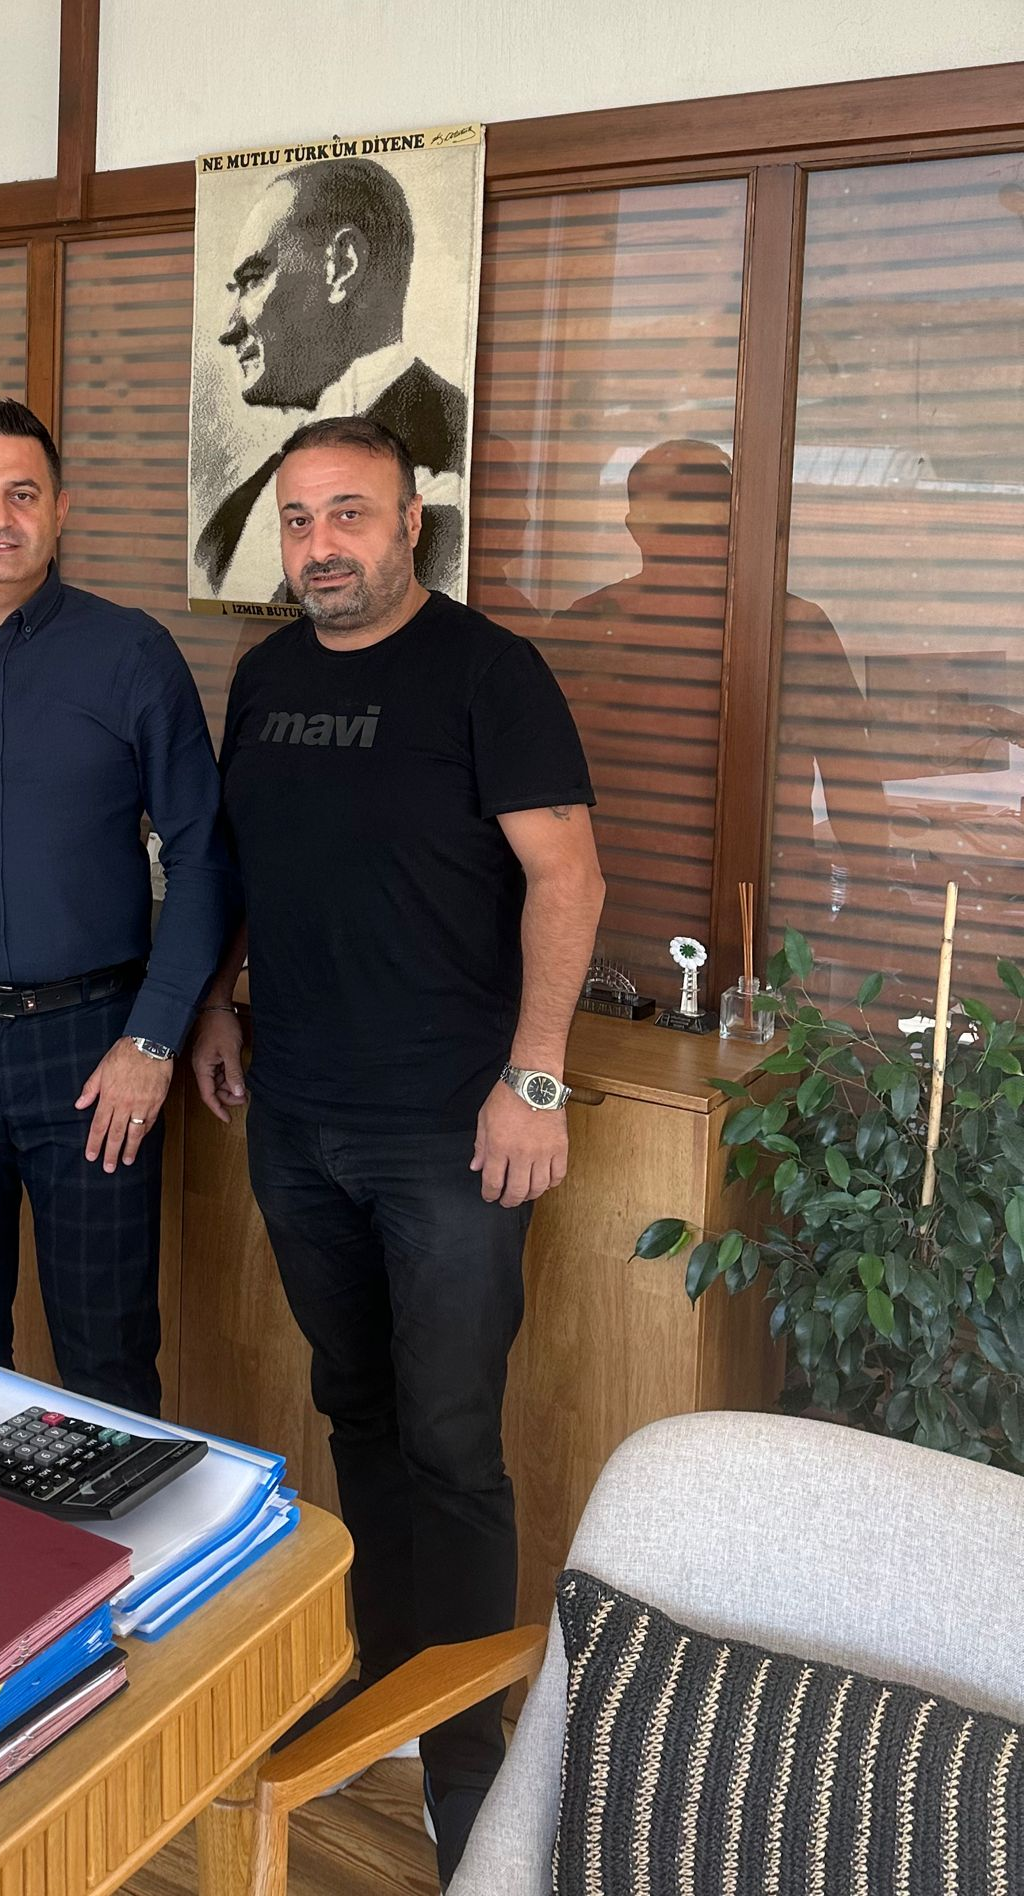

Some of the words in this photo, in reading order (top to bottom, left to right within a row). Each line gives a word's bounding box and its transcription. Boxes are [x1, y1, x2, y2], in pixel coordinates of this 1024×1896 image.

[202, 156, 224, 172] NE
[226, 149, 281, 169] MUTLU
[365, 133, 425, 155] DİYENE
[259, 704, 382, 748] mavi
